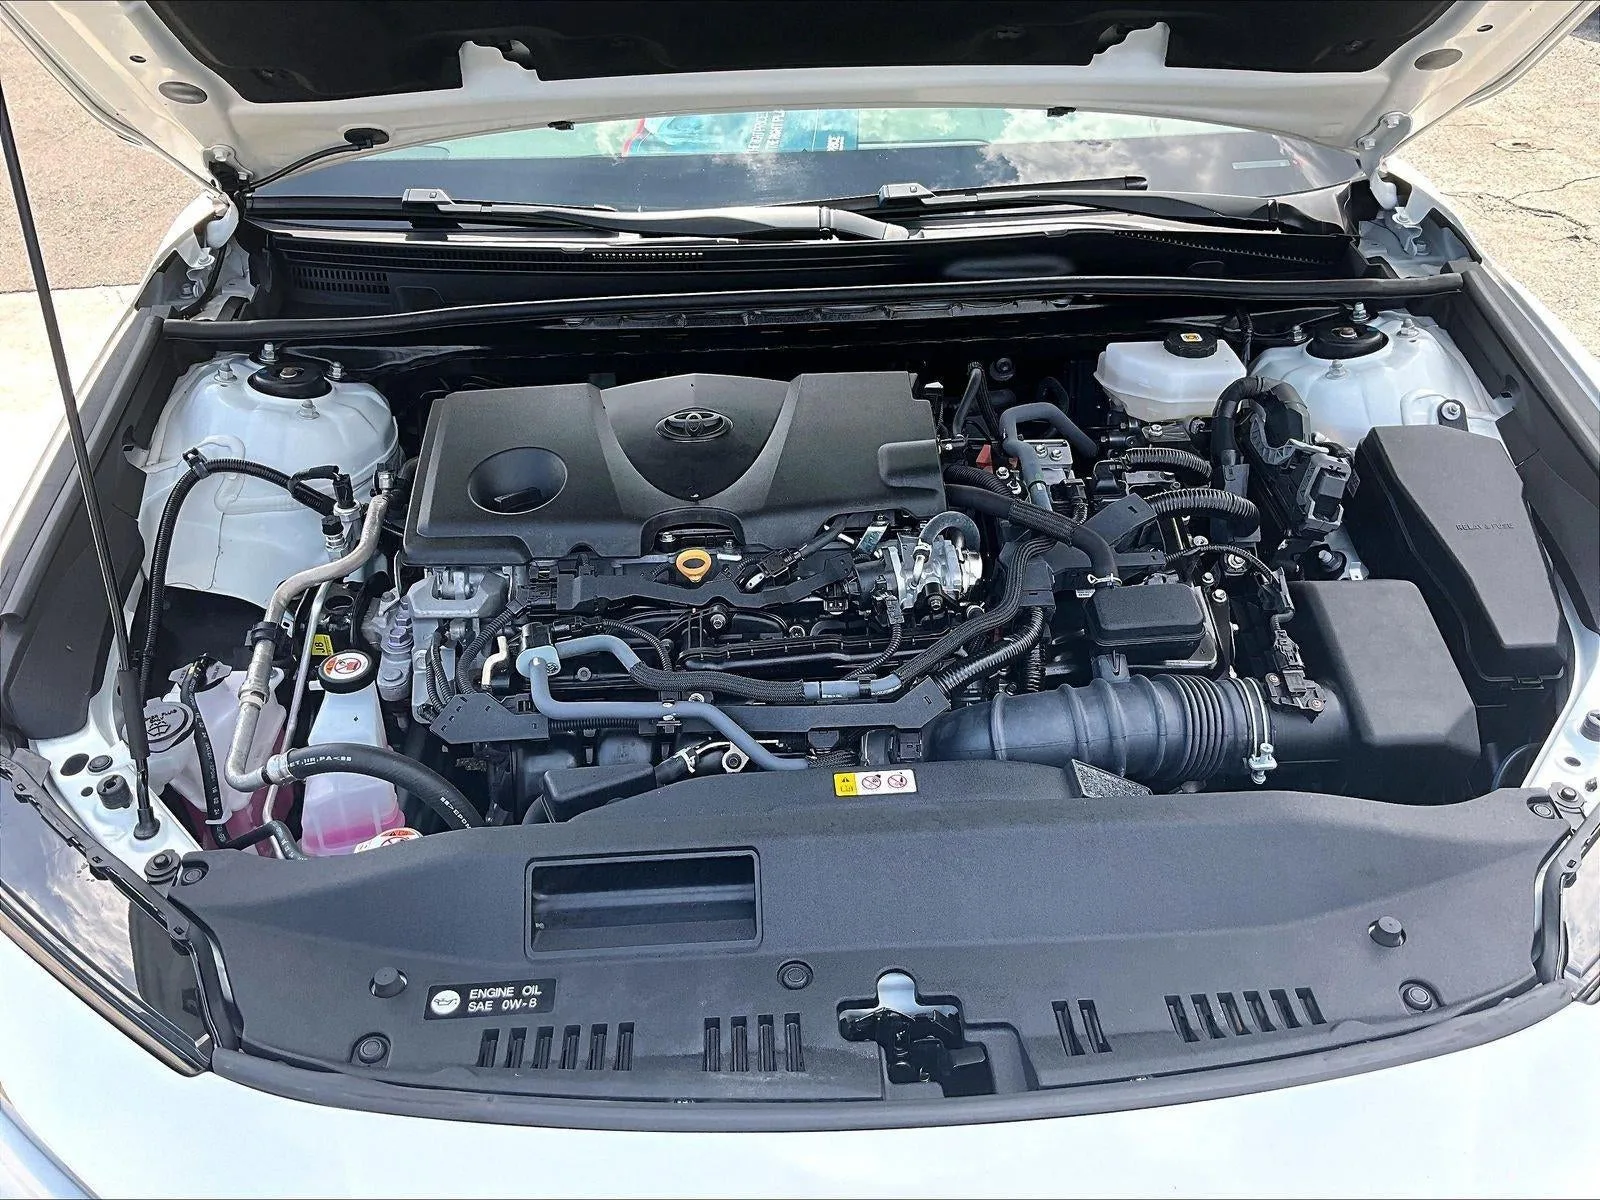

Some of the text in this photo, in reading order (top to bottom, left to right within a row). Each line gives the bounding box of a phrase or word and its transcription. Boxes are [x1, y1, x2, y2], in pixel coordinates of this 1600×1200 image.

[1456, 523, 1482, 531] RELAY
[315, 642, 325, 653] J8
[470, 985, 542, 999] ENGINE OIL
[467, 998, 537, 1012] SAE 0W-8
